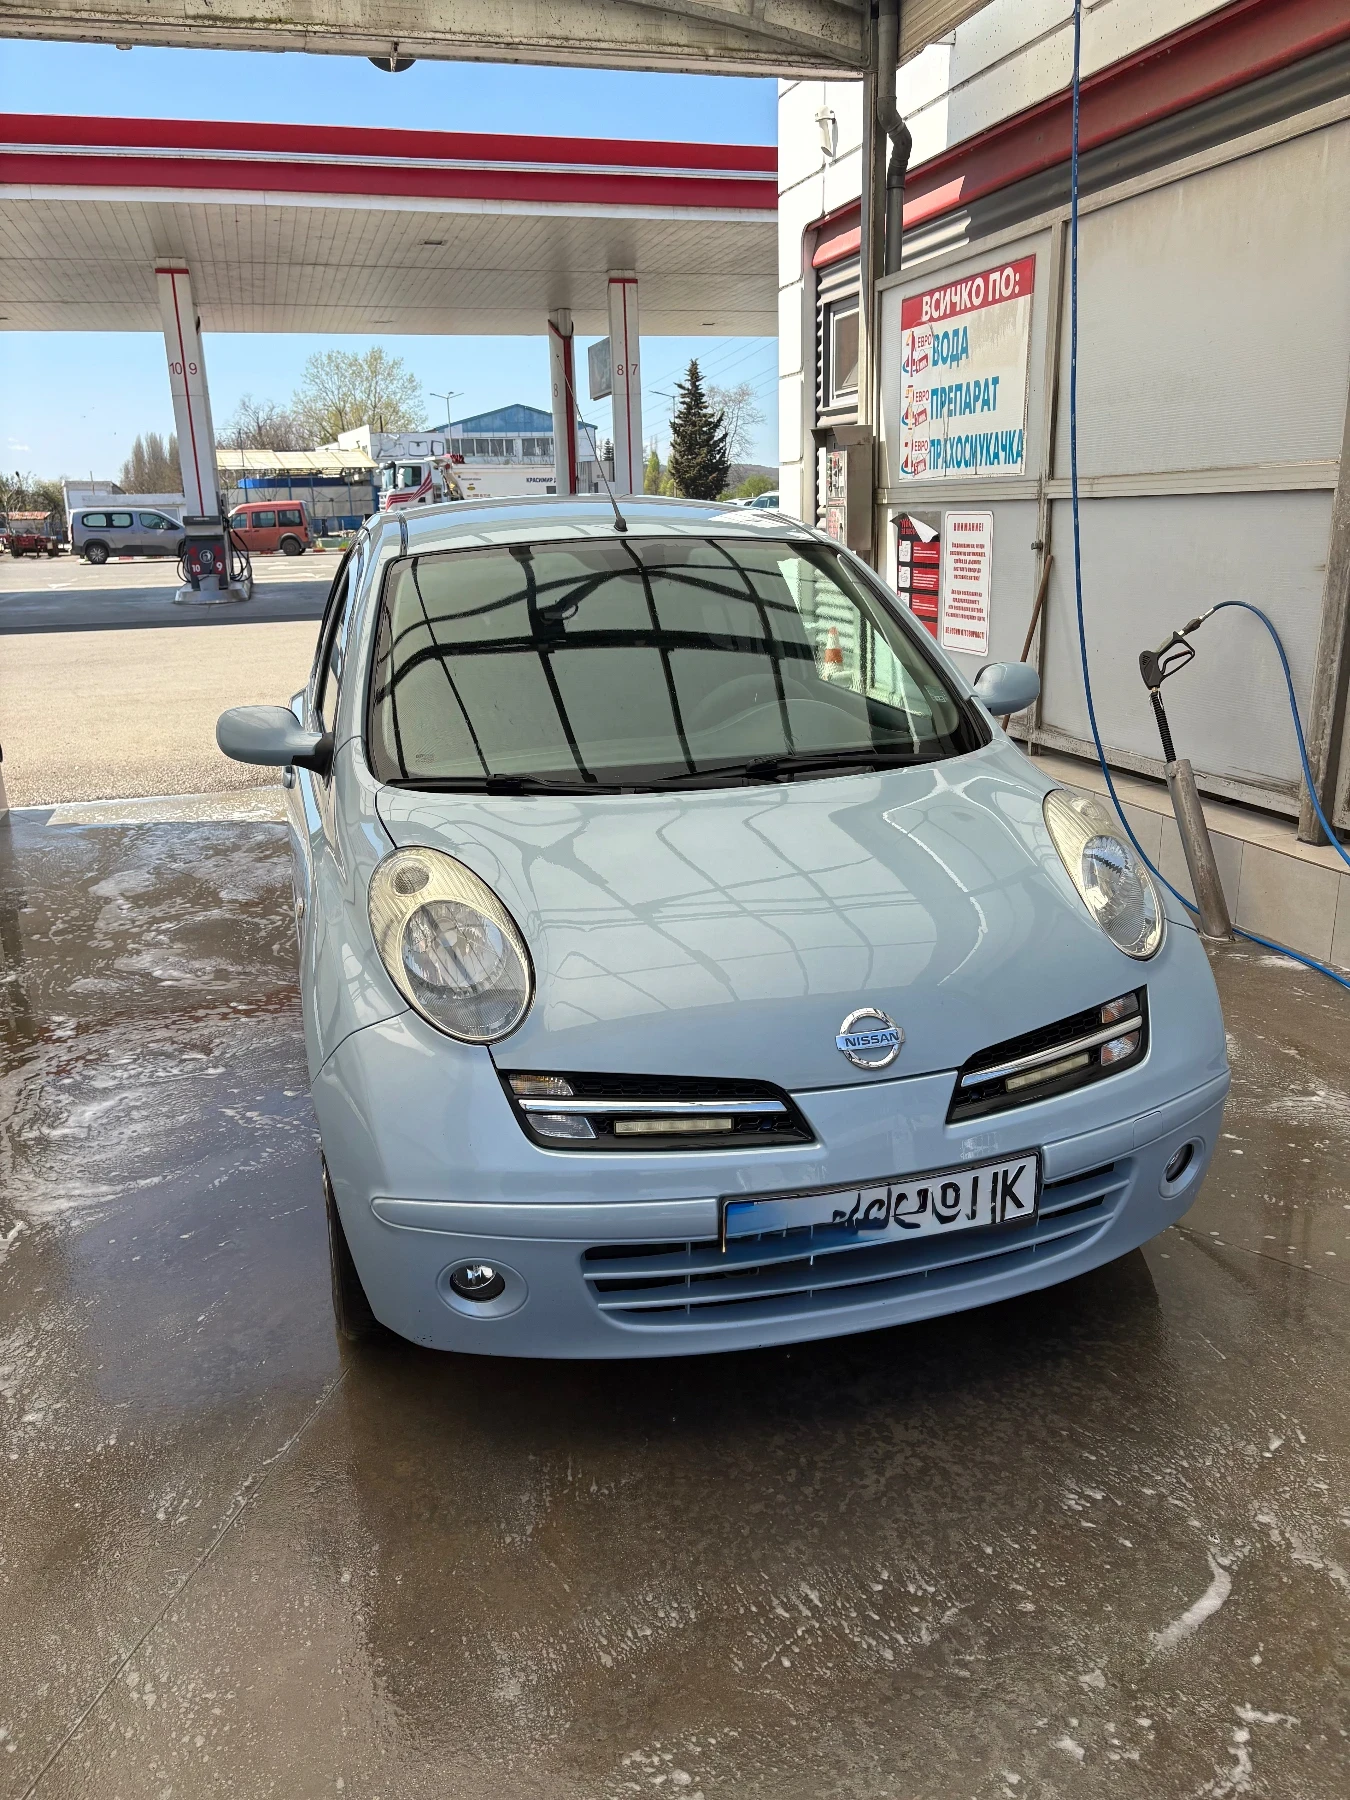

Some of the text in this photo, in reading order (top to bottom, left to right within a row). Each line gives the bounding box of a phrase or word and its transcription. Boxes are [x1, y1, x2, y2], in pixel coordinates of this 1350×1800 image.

[921, 266, 1020, 322] ВСИЧКО ПО:
[917, 333, 932, 349] ЕВРО
[932, 325, 970, 370] ВОДА
[170, 362, 182, 375] 10
[188, 362, 198, 375] 9
[617, 364, 624, 376] 8
[630, 363, 638, 376] 7
[553, 383, 559, 398] 8
[915, 389, 929, 403] ЕВРО
[930, 375, 999, 420] ПРЕПАРАТ
[914, 429, 1022, 470] ЕВРО ПРАХОСМУКАЧКА
[191, 564, 201, 573] 10
[216, 561, 223, 571] 9
[845, 1031, 900, 1047] NISSAN
